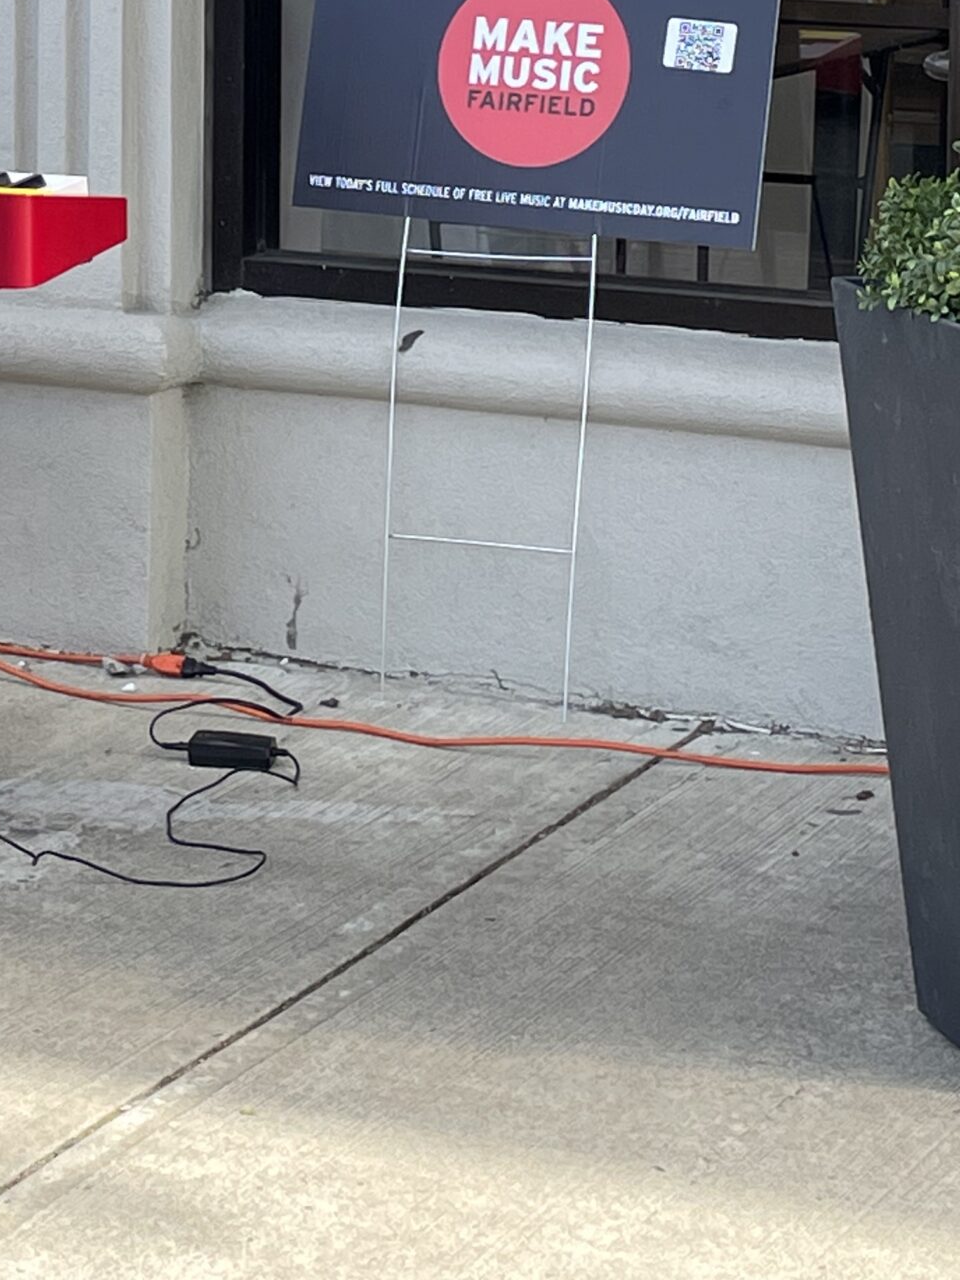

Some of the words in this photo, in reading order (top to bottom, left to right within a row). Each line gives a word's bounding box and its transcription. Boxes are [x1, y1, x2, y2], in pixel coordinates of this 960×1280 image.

[473, 16, 604, 59] MAKE
[468, 53, 600, 94] MUSIC
[467, 90, 595, 117] FAIRFIELD
[309, 174, 333, 188] VIEW
[335, 176, 373, 192] TODAY'S
[375, 180, 399, 194] FULL
[401, 182, 450, 199] SCHEDULE
[452, 187, 465, 200] OF
[469, 188, 493, 202] FREE
[495, 191, 517, 205] LIVE
[519, 193, 550, 208] MUSIC
[553, 196, 566, 208] AT
[568, 197, 741, 224] MAKEMUSICDAY.ORG/FAIRFIELD
